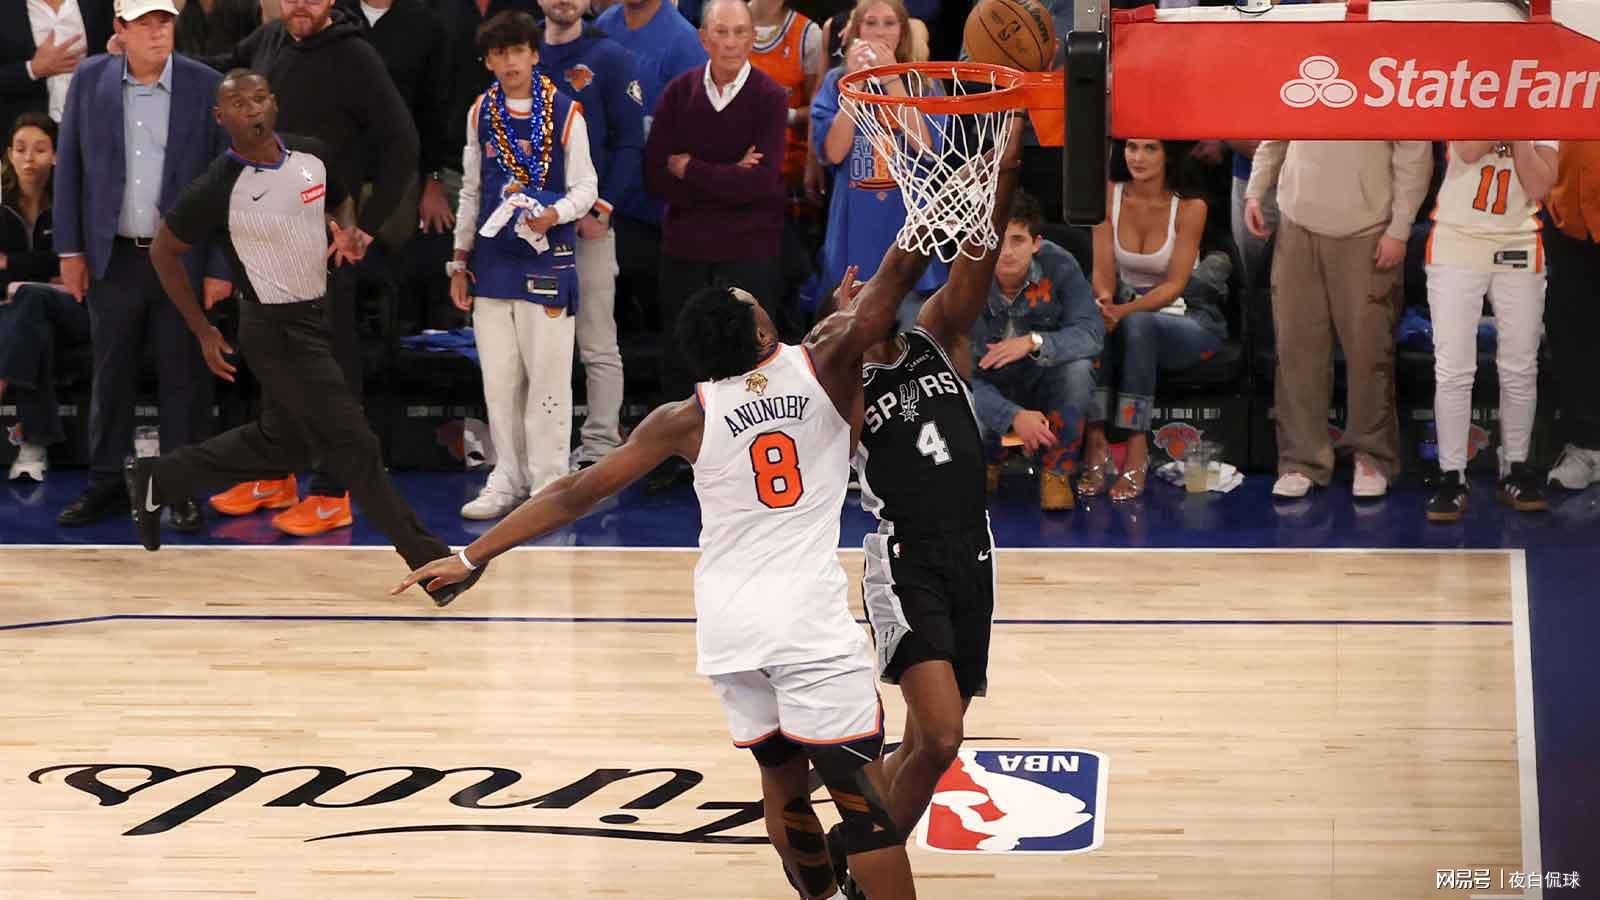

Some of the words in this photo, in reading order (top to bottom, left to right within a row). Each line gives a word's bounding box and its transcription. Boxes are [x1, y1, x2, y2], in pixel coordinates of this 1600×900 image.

[1363, 57, 1500, 109] State
[1472, 165, 1511, 215] 11
[724, 395, 810, 438] ANUNOBY
[864, 371, 959, 434] SPURS
[916, 420, 953, 466] 4
[749, 430, 804, 509] 8
[999, 754, 1080, 774] NBA
